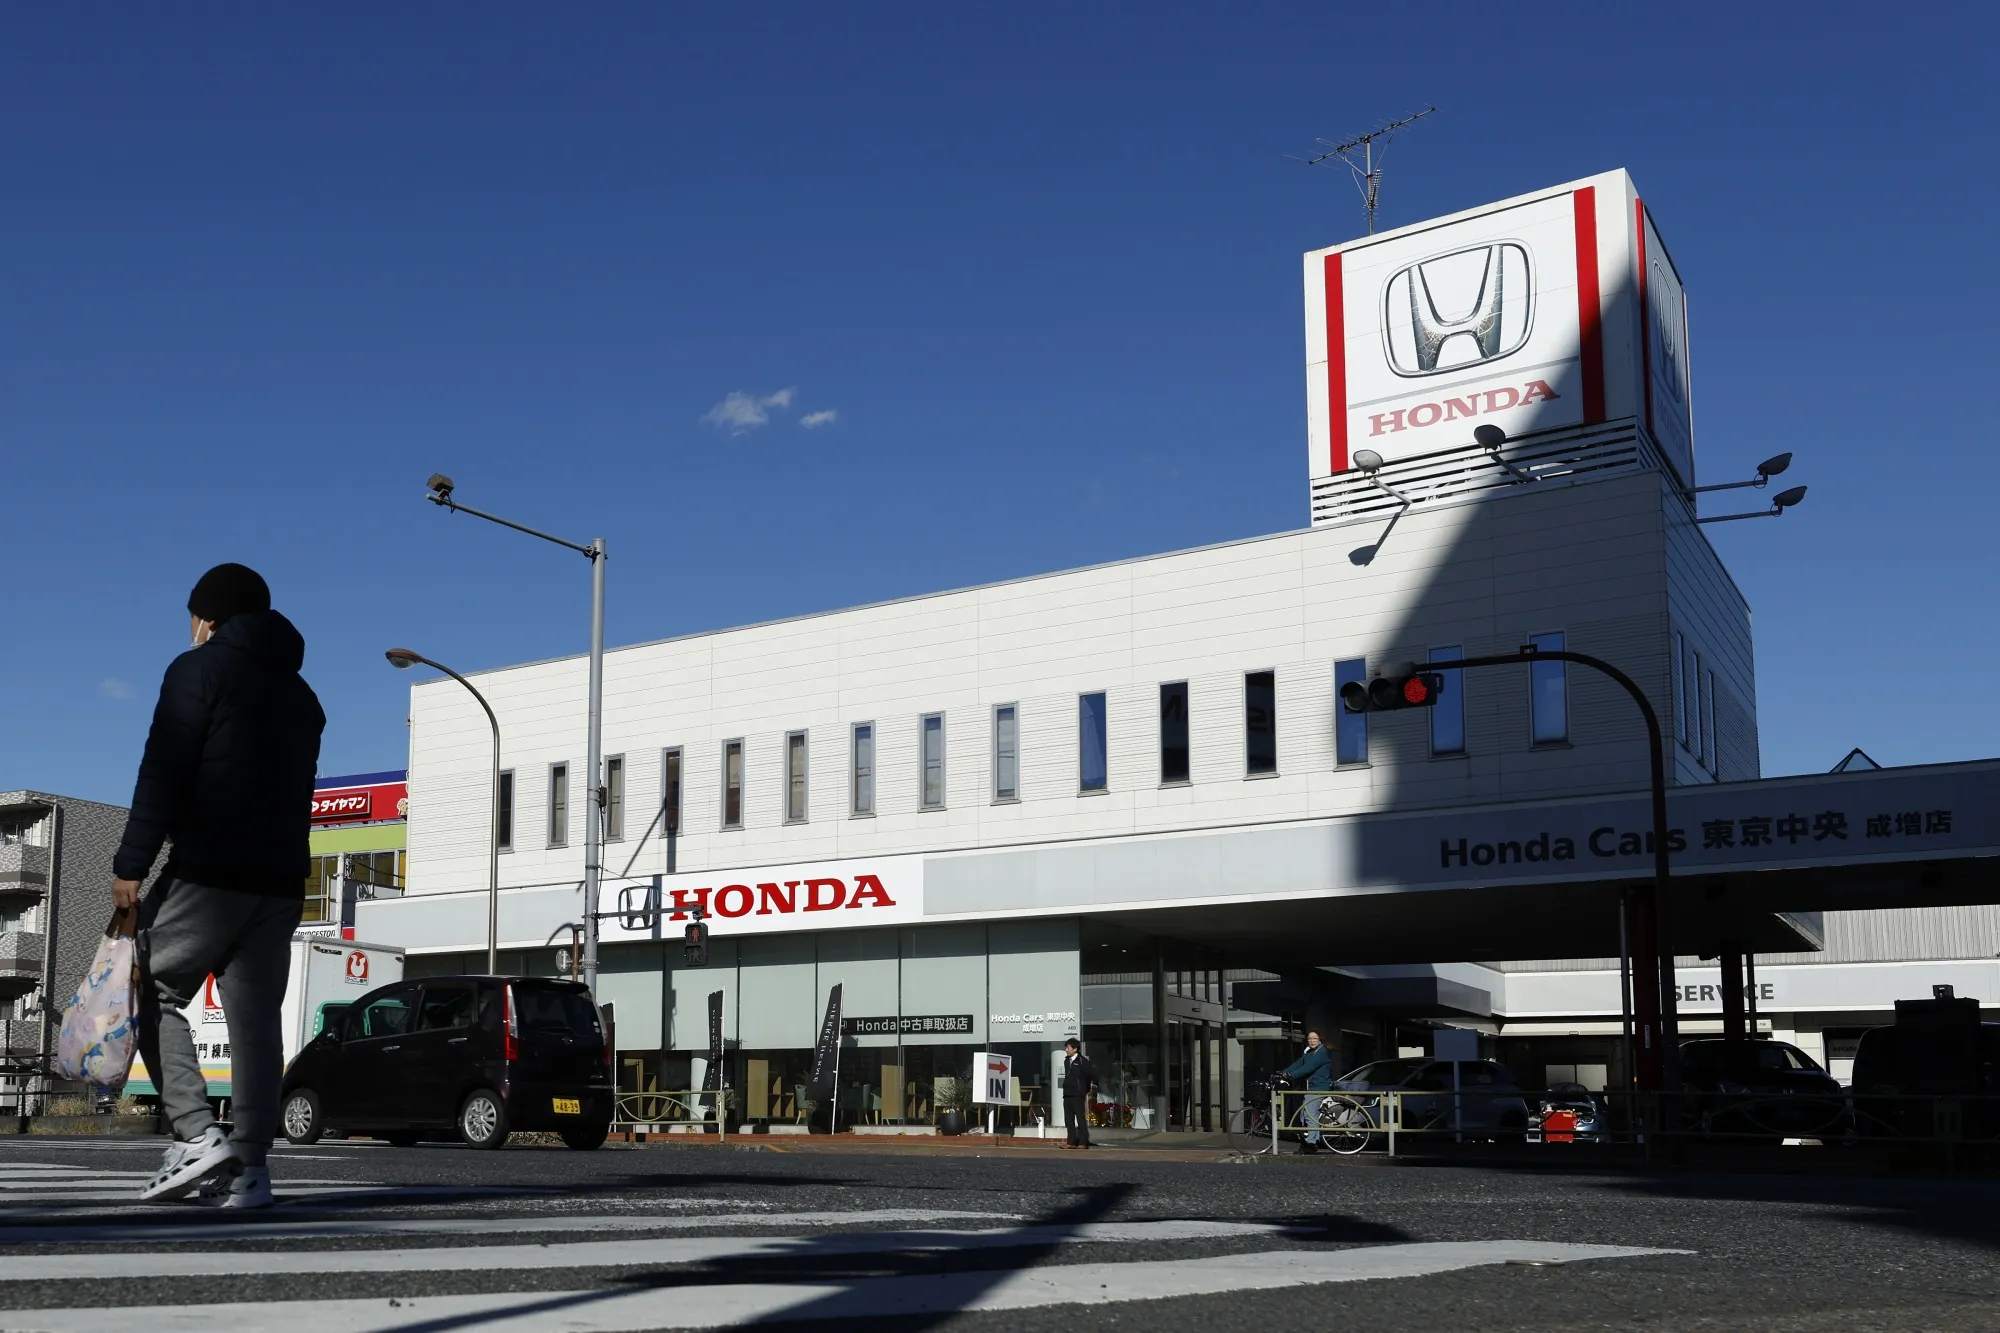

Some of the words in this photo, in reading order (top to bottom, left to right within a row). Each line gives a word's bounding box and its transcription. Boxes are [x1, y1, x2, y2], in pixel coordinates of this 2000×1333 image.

[1368, 379, 1561, 437] HONDA
[320, 796, 366, 812] タイヤマン
[1440, 832, 1575, 868] Honda
[1702, 810, 1848, 849] 東京中央
[1865, 810, 1953, 838] 成増店
[669, 874, 896, 921] HONDA
[856, 1019, 896, 1031] Honda
[900, 1017, 968, 1031] 中古車取扱店
[991, 1014, 1020, 1022] Honda
[1023, 1013, 1043, 1022] Cars
[990, 1078, 1005, 1098] IN
